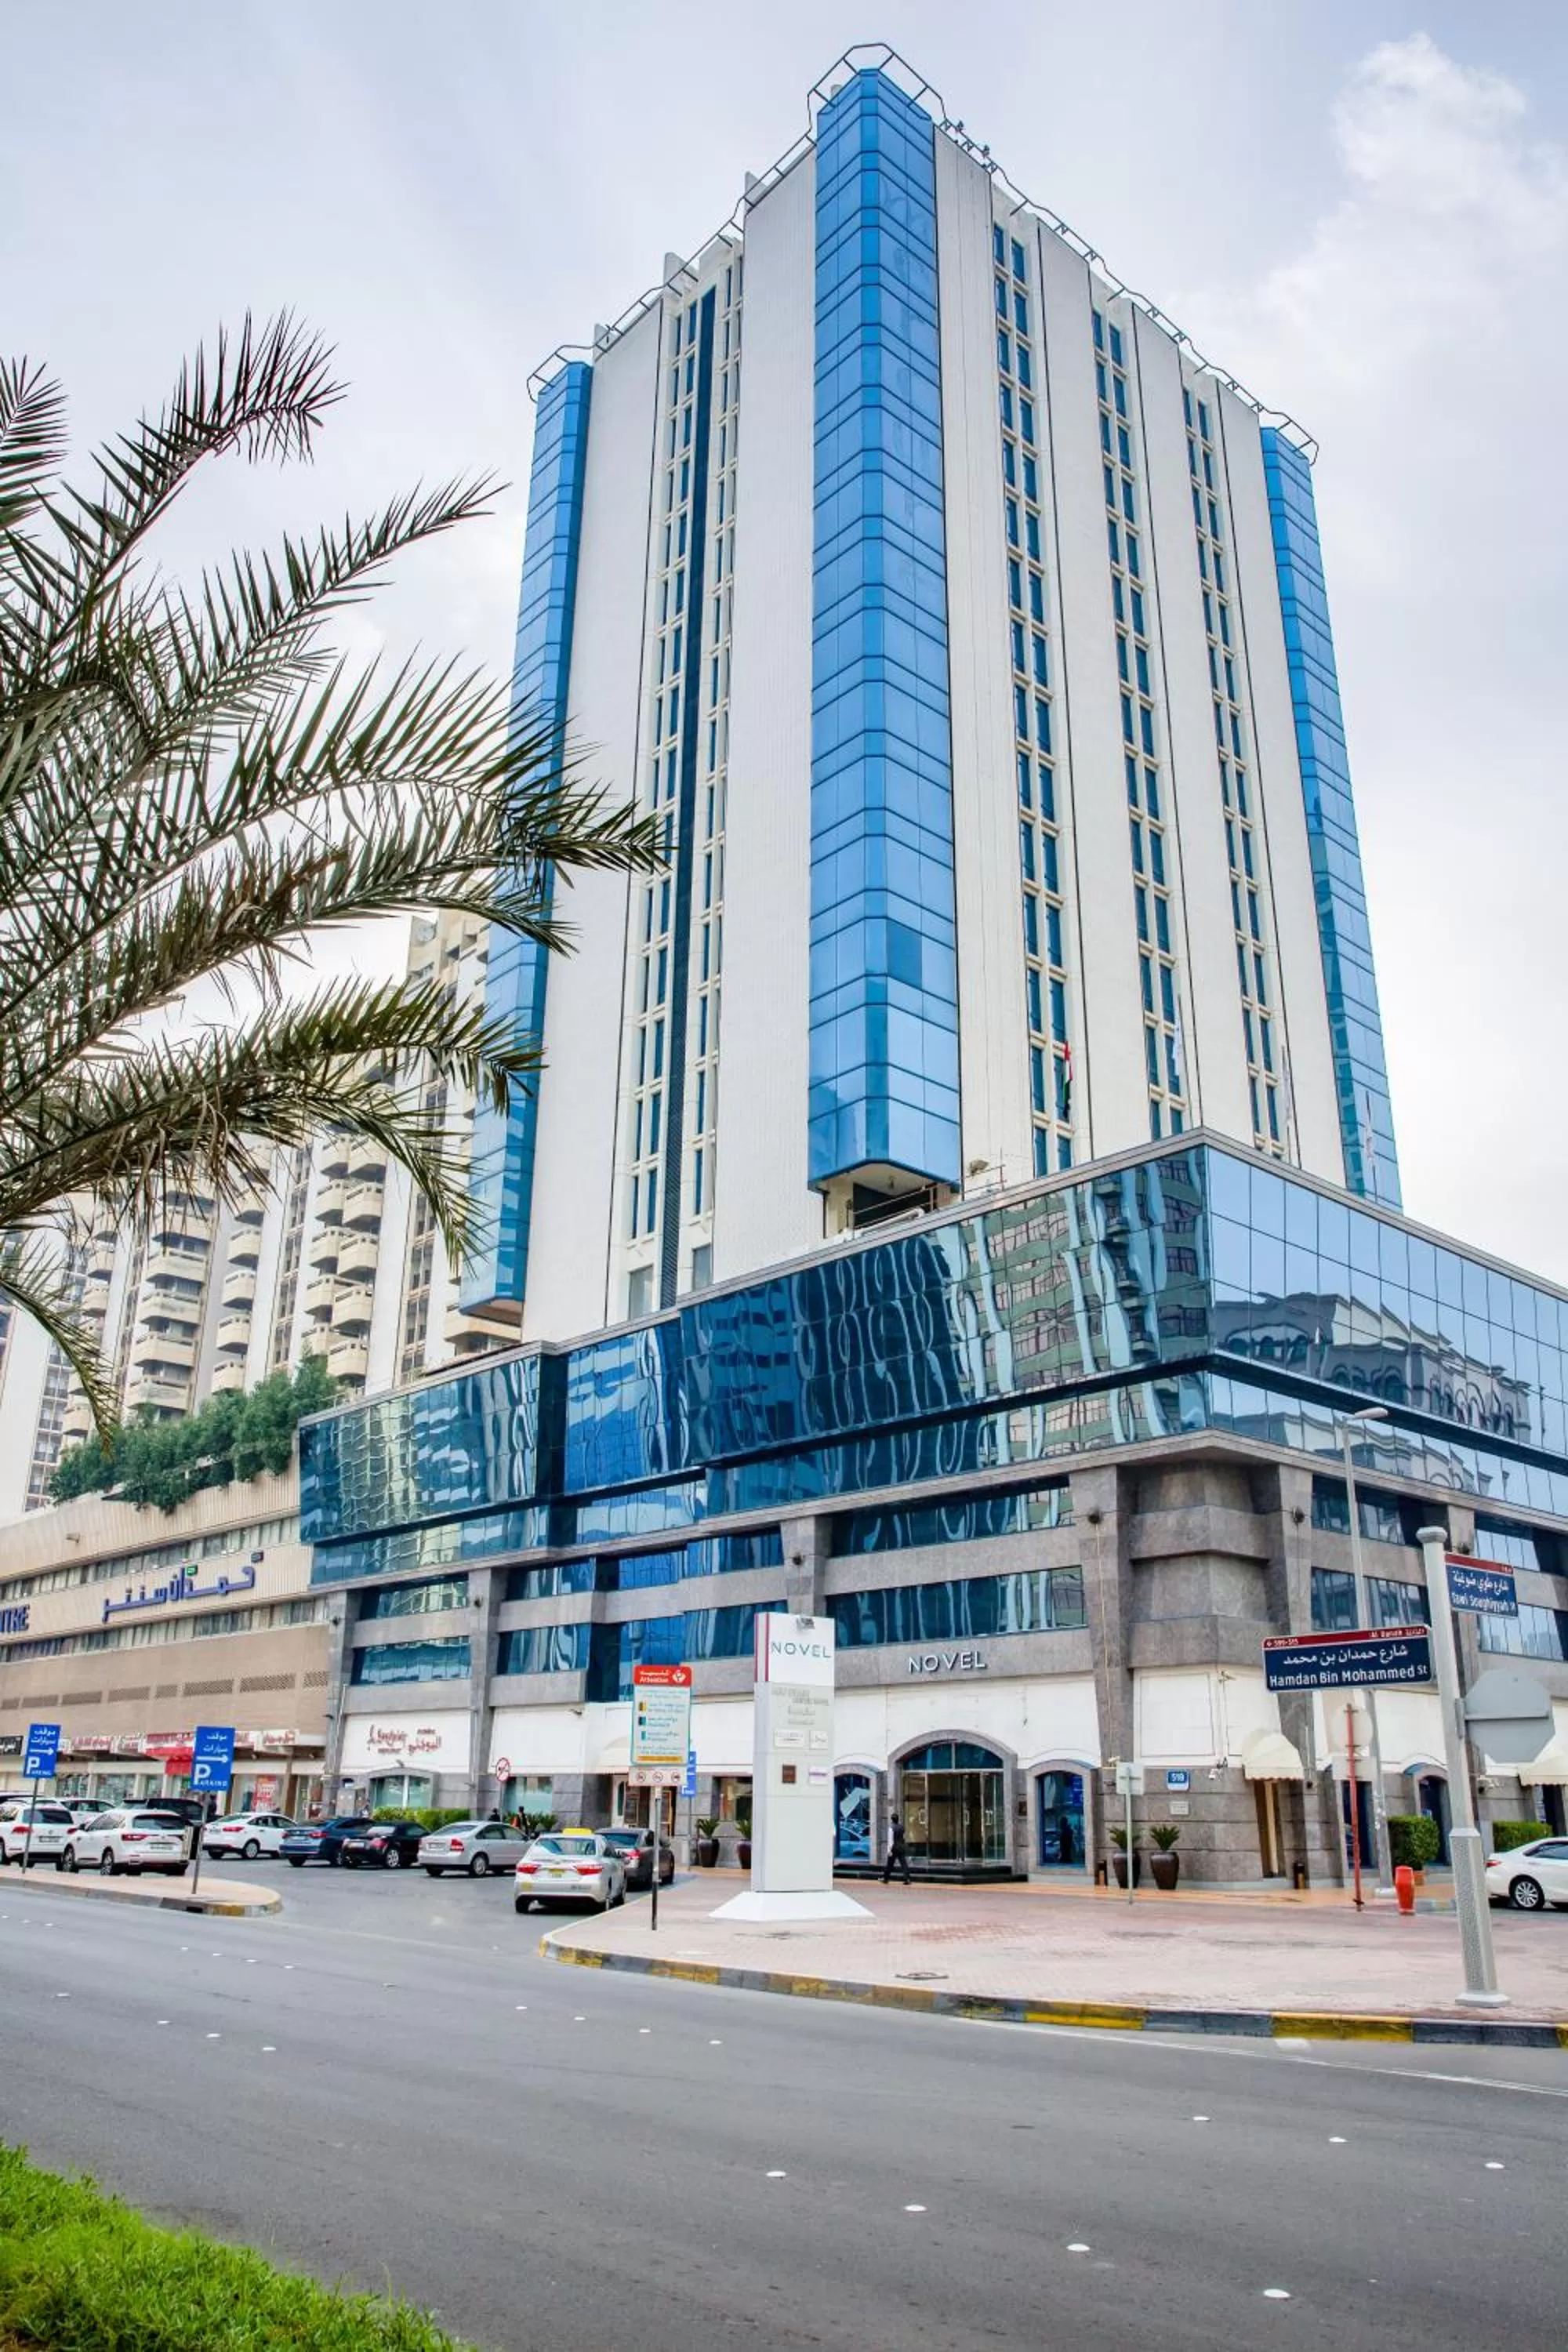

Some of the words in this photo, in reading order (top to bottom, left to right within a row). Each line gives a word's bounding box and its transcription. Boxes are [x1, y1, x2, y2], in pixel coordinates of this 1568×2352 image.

[771, 1642, 831, 1658] NOVEL
[1338, 1649, 1377, 1663] حمدان
[1379, 1645, 1408, 1664] شارع
[909, 1650, 987, 1674] NOVEL
[1283, 1653, 1318, 1665] محمد
[1319, 1651, 1336, 1666] بن
[1269, 1674, 1317, 1687] Hamdan
[1319, 1671, 1338, 1684] Bin
[1341, 1665, 1415, 1682] Mohammed
[1417, 1665, 1428, 1675] St
